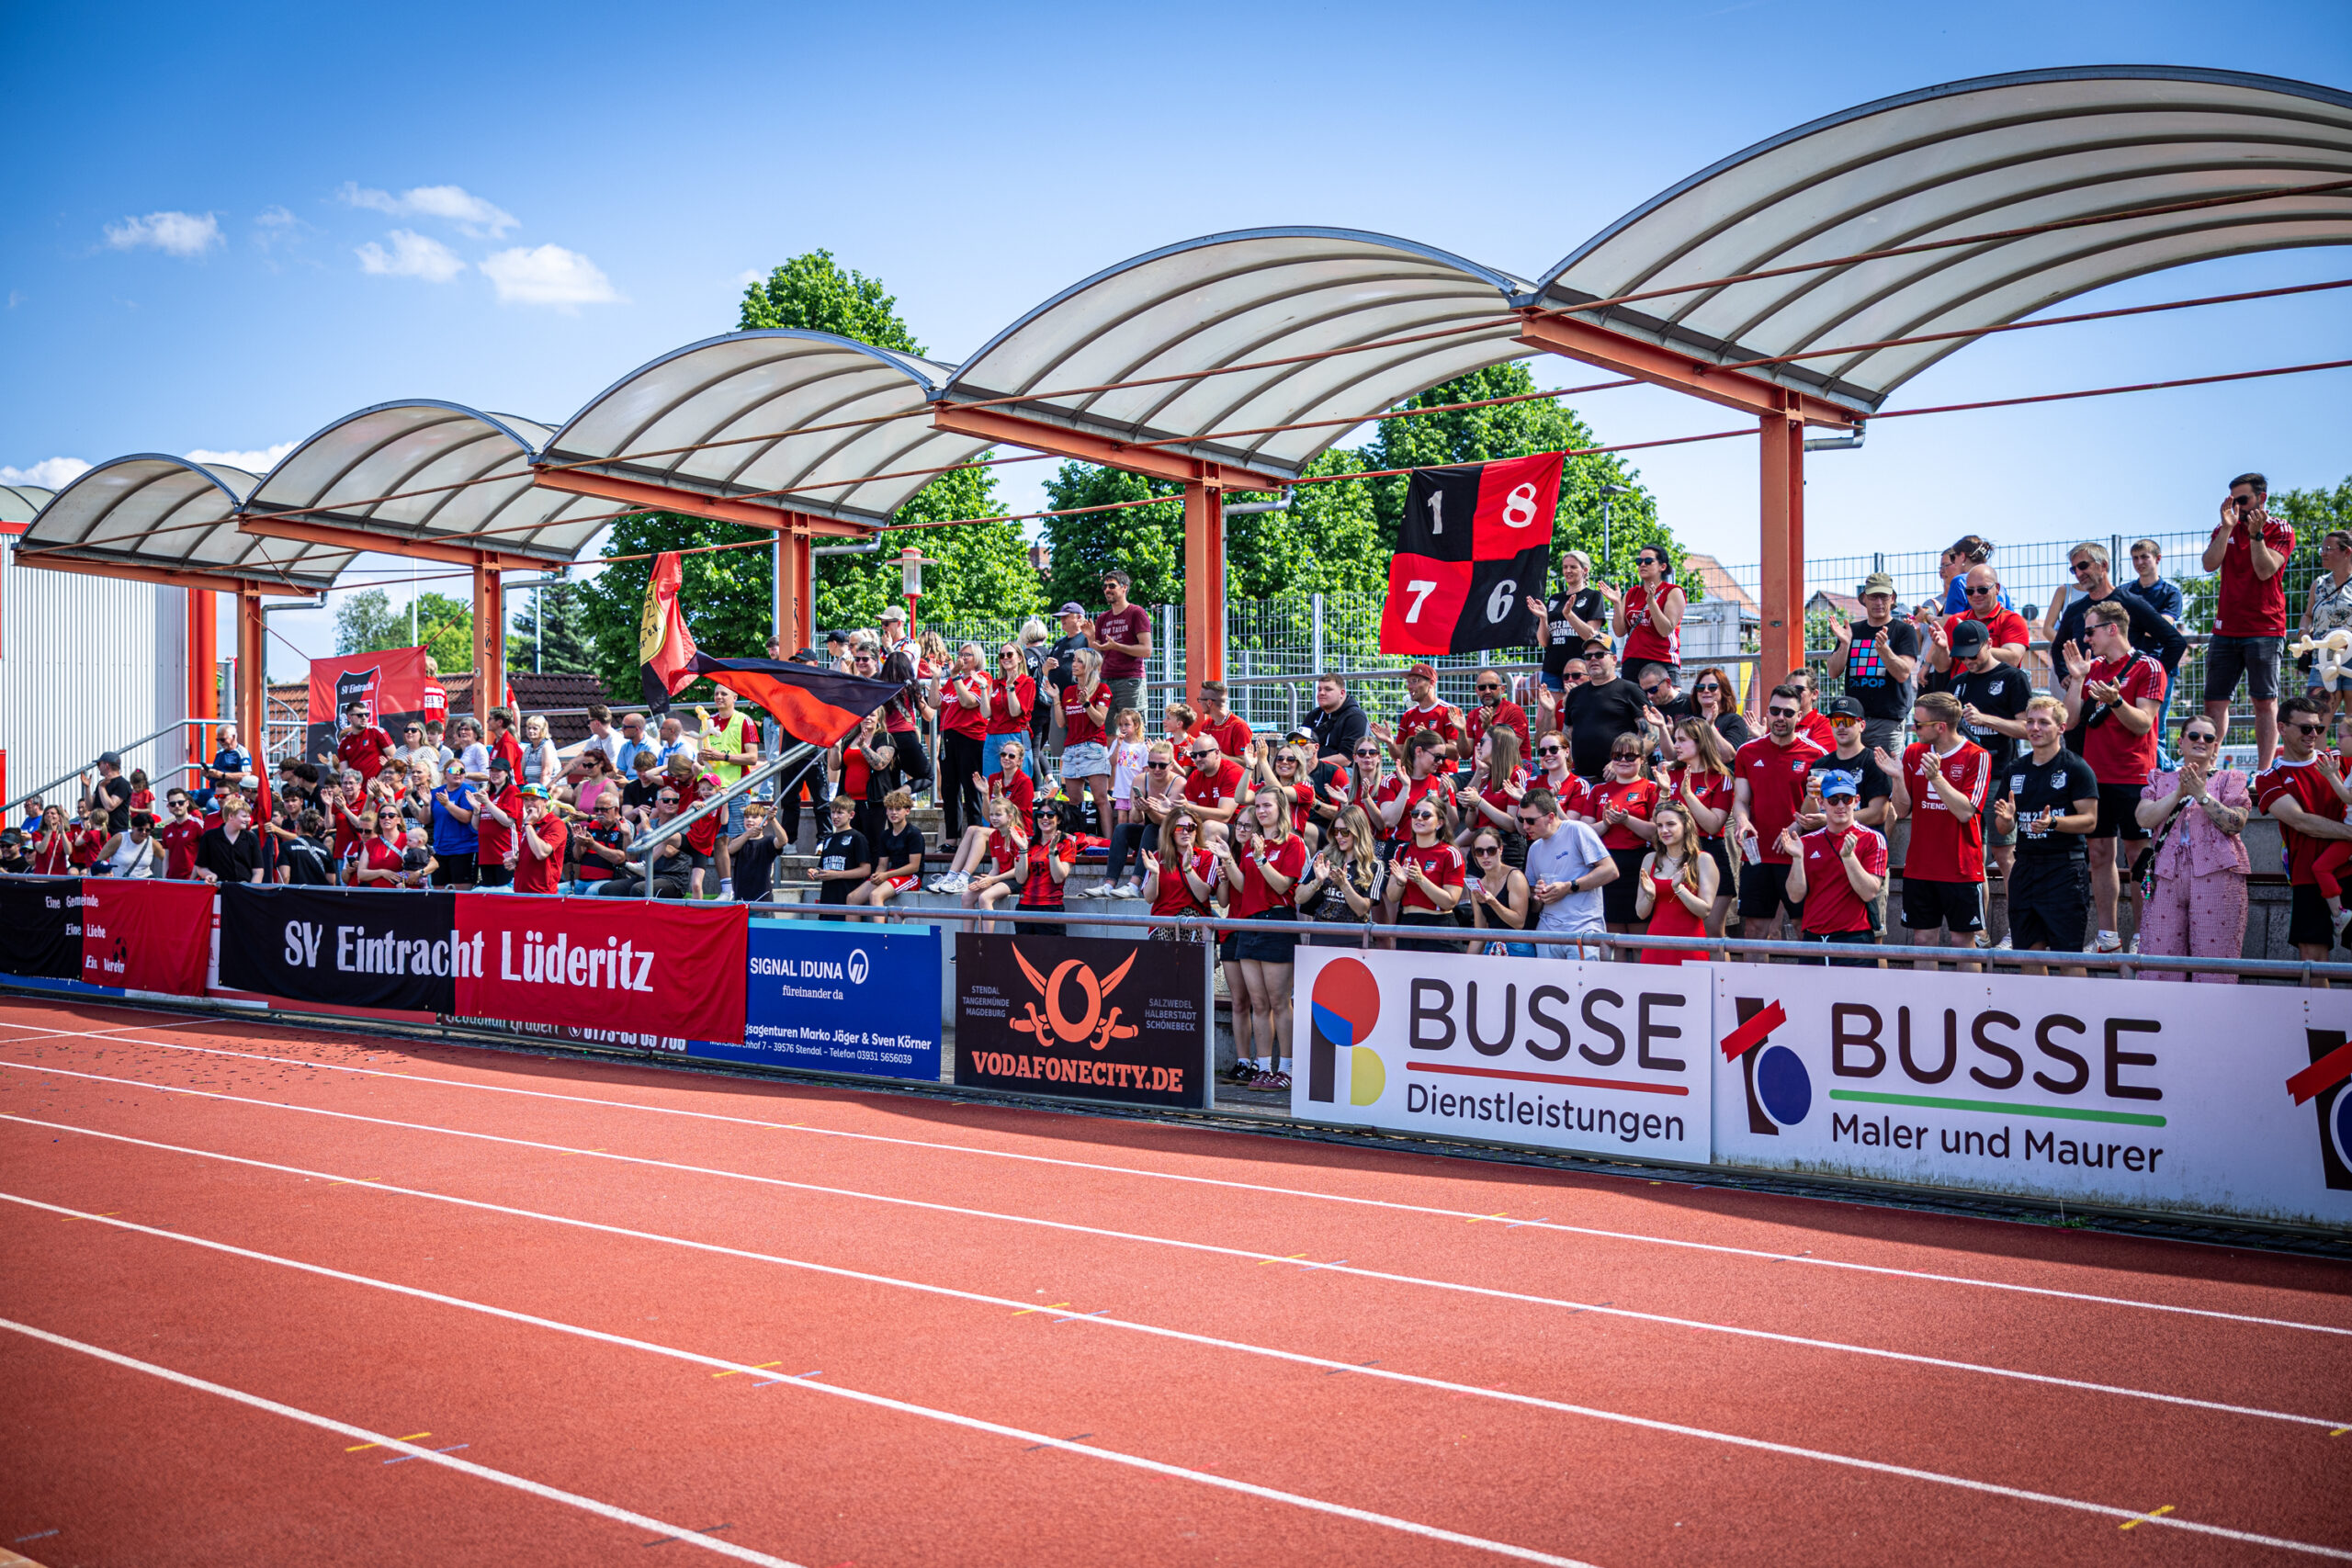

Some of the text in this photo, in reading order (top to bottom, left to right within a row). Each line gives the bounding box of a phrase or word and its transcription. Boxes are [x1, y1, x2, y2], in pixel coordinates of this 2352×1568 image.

[1428, 482, 1537, 535] 1 8
[1406, 580, 1516, 624] 7 6
[341, 681, 374, 695] SV Eintracht
[1860, 678, 1886, 688] POP
[2236, 755, 2258, 764] BUS
[1921, 800, 1948, 810] STEND
[46, 894, 98, 908] Eine Gemeinde
[66, 923, 106, 938] Eine Liebe
[285, 919, 655, 993] SV Eintracht Lüderitz
[104, 957, 125, 974] Verein
[750, 957, 843, 979] SIGNAL IDUNA
[783, 985, 843, 999] füreinander da
[971, 985, 1000, 995] STENDAL
[963, 996, 1010, 1008] TANGERMÜNDE
[1148, 998, 1193, 1010] SALZWEDEL
[966, 1007, 1006, 1018] MAGDEBURG
[1145, 1009, 1196, 1021] HALBERSTADT
[1146, 1018, 1195, 1032] SCHÖNEBECK
[1409, 977, 1687, 1072] BUSSE
[799, 1027, 831, 1041] Marko
[832, 1030, 858, 1045] Jäger
[862, 1032, 869, 1044] &
[872, 1033, 896, 1047] Sven
[898, 1035, 932, 1050] Körner
[763, 1042, 767, 1050] 7
[773, 1043, 795, 1054] 39576
[796, 1044, 822, 1056] Stendal
[830, 1047, 855, 1059] Telefon
[856, 1050, 878, 1062] 03931
[880, 1053, 912, 1065] 5656039
[1832, 1001, 2163, 1101] BUSSE
[971, 1051, 1183, 1092] VODAFONECITY.DE
[1408, 1083, 1684, 1144] Dienstleistungen
[1832, 1111, 2163, 1174] Maler und Maurer
